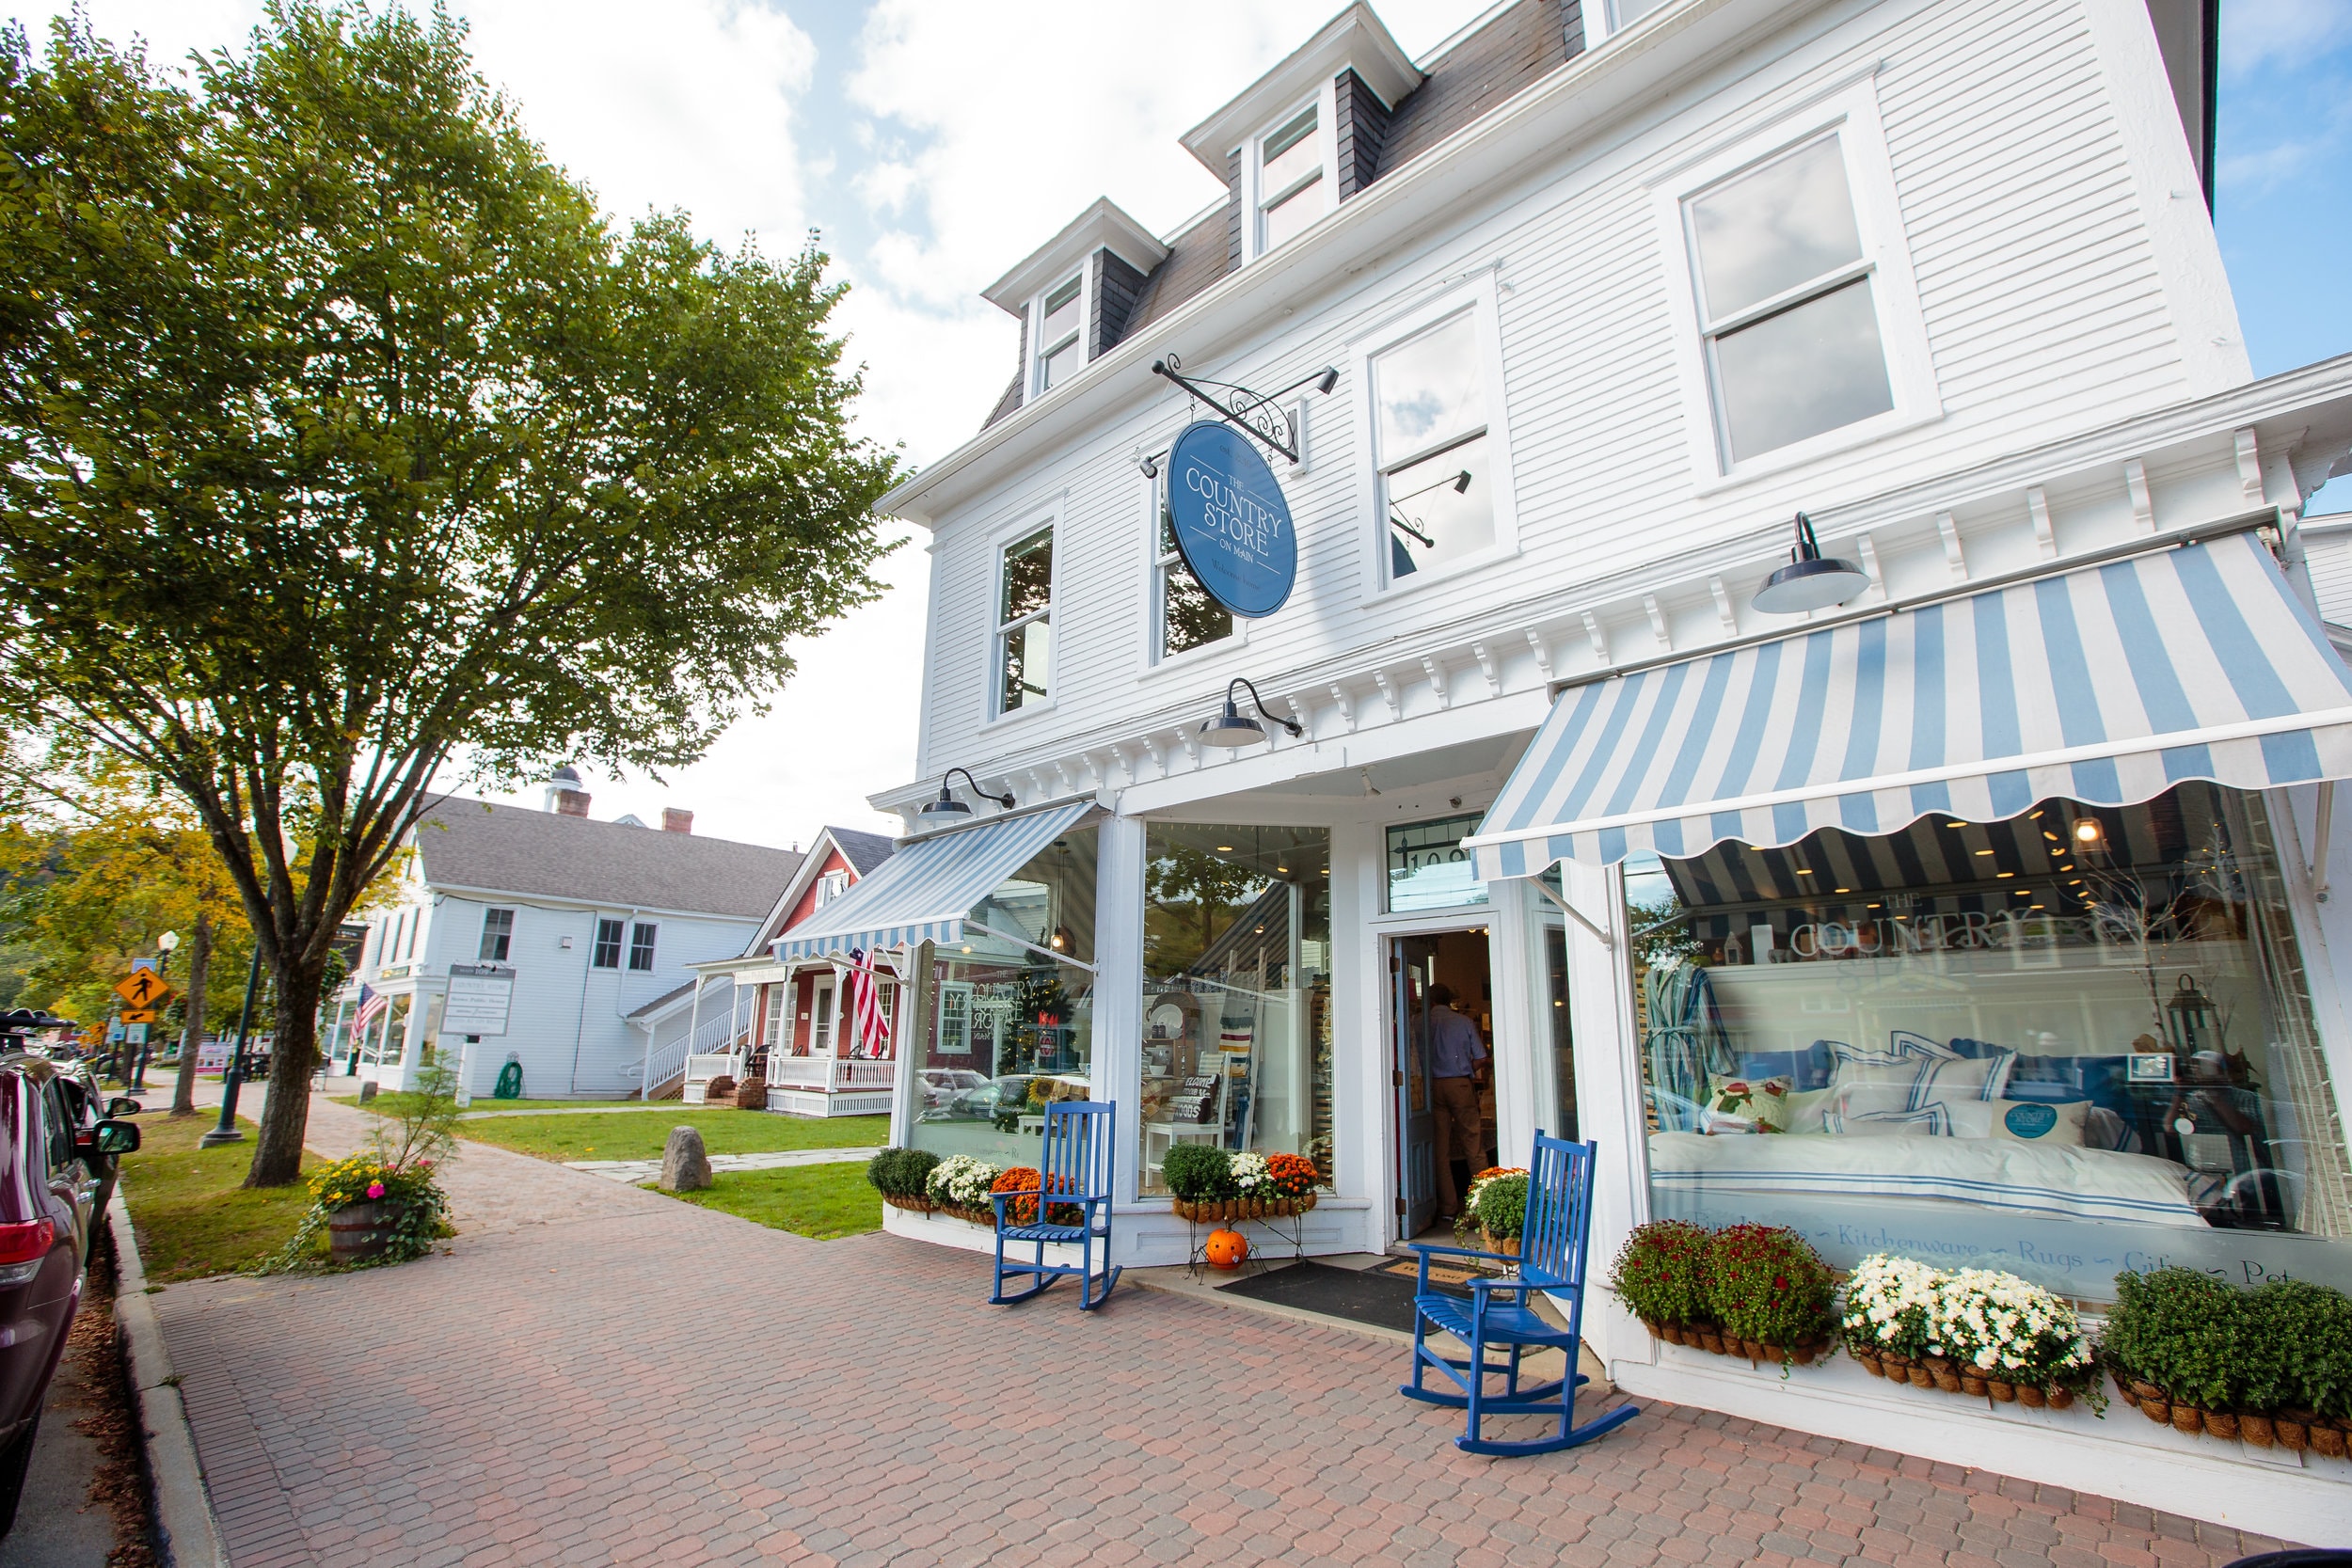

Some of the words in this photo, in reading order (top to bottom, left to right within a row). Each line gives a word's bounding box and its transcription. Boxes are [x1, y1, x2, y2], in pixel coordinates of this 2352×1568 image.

[1228, 474, 1245, 492] THE
[1186, 467, 1282, 538] COUNTRY
[1204, 502, 1269, 557] STORE
[1219, 538, 1232, 552] ON
[1233, 545, 1254, 563] MAIN
[1211, 558, 1242, 580] Welcome
[1882, 893, 1923, 911] THE
[1790, 907, 2036, 958] COUNTRY
[968, 980, 1039, 1000] OUNTRY
[1838, 1225, 1979, 1258] Kitchenware
[2018, 1241, 2084, 1274] Rugs
